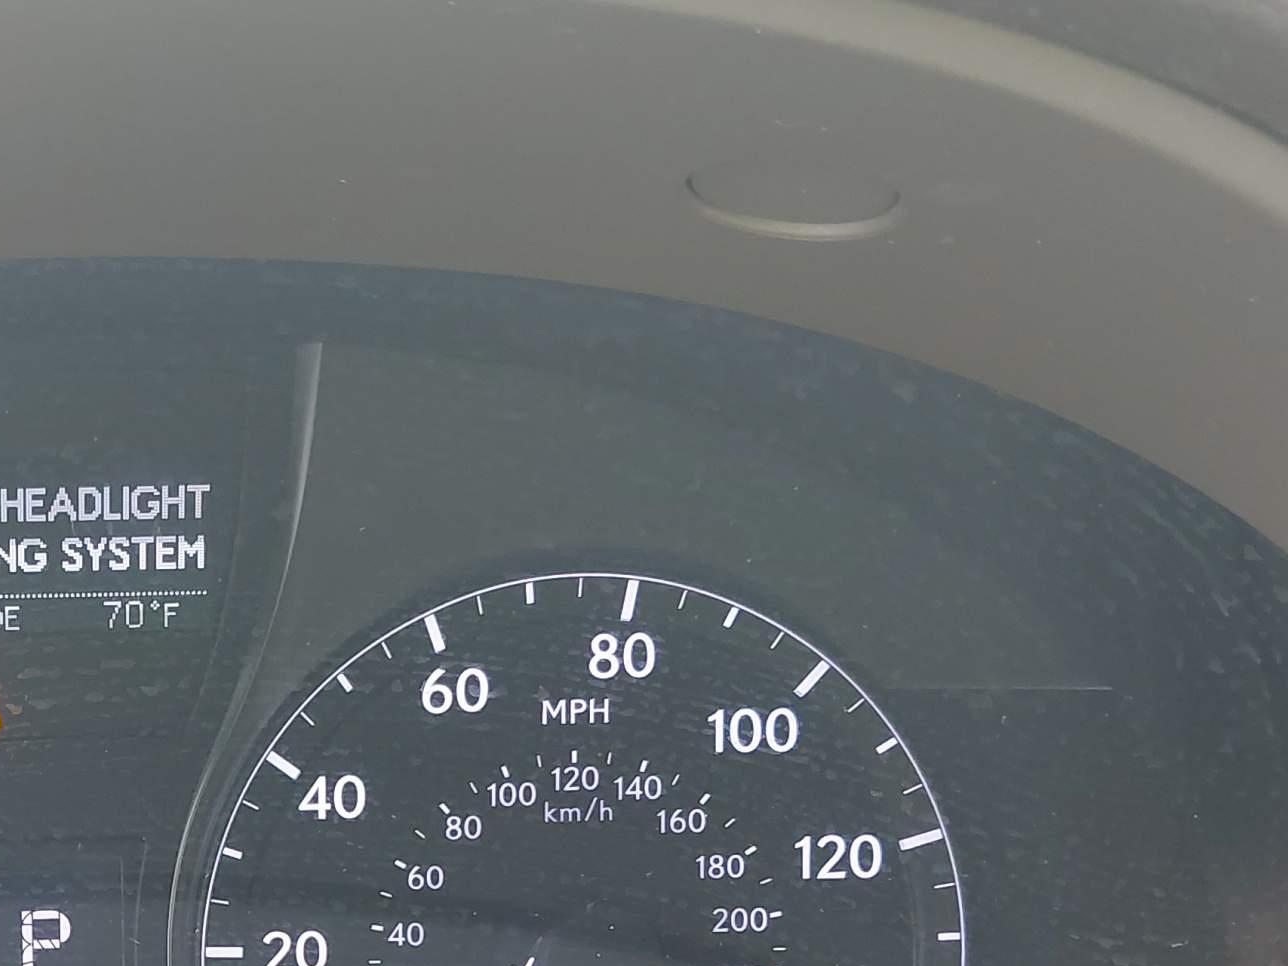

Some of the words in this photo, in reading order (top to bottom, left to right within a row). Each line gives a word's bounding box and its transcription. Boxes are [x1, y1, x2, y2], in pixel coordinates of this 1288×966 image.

[0, 484, 211, 523] HEADLIGHT
[61, 535, 206, 573] SYSTEM
[103, 600, 180, 630] 70°F
[588, 631, 656, 680] 80
[421, 667, 490, 716] 60
[541, 698, 610, 724] MPH
[707, 706, 799, 755] 100
[551, 766, 600, 792] 120
[613, 774, 663, 801] 140
[298, 774, 367, 820] 40
[487, 782, 537, 808] 100
[543, 797, 614, 823] km/h
[656, 808, 707, 834] 160
[444, 815, 482, 841] 80
[695, 853, 745, 880] 180
[793, 833, 883, 881] 120
[407, 865, 445, 891] 60
[712, 907, 768, 933] 200
[387, 922, 425, 947] 40
